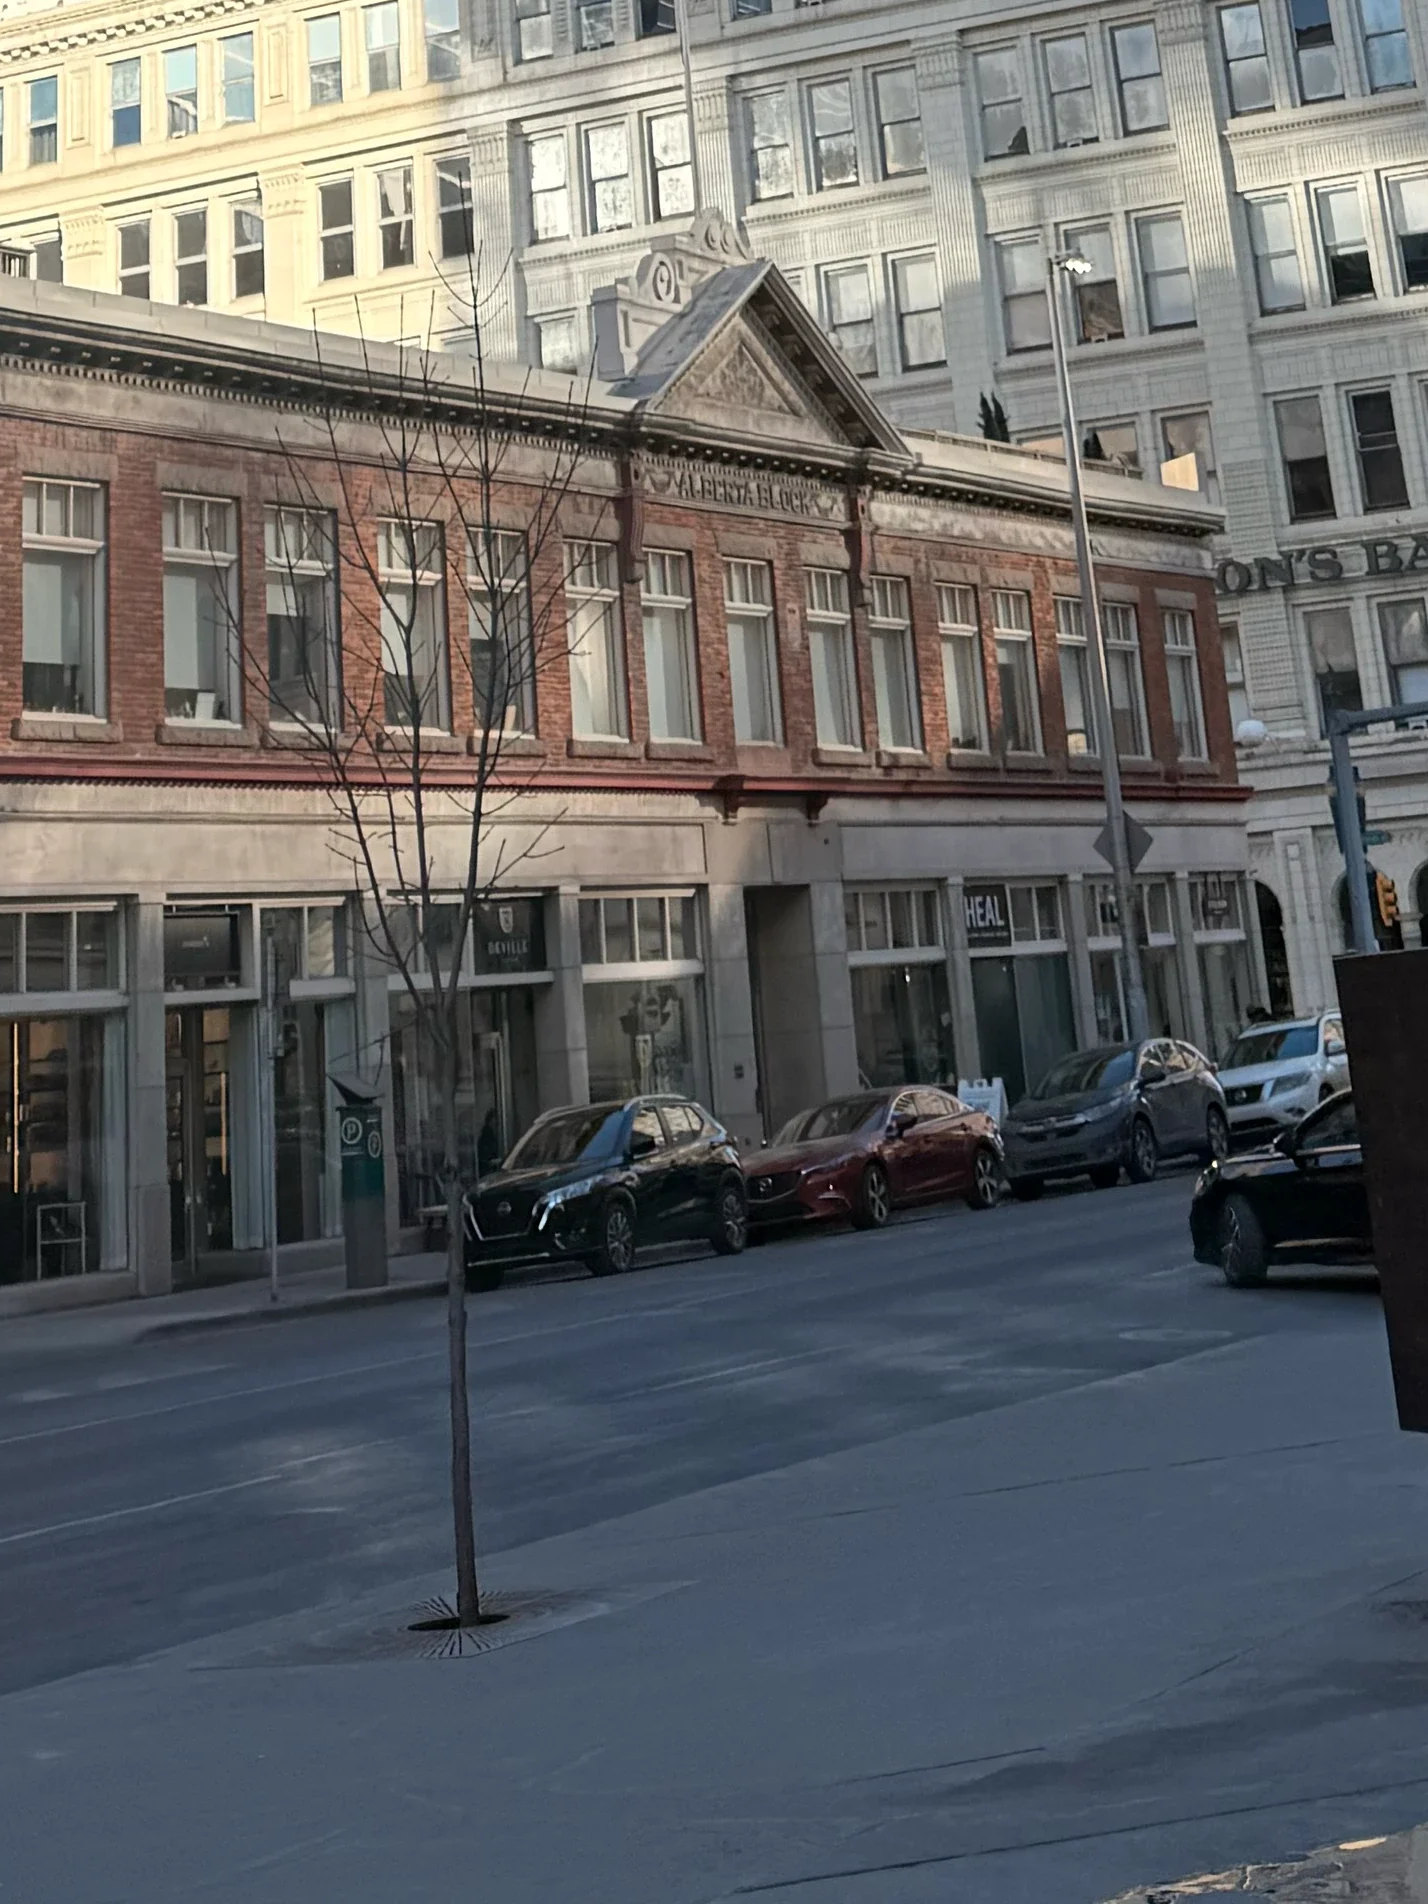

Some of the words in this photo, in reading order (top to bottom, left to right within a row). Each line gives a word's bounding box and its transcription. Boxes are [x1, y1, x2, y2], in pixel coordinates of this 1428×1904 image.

[675, 472, 754, 506] ALBERTA
[756, 484, 810, 516] BLOCK
[963, 895, 1005, 928] HEAL
